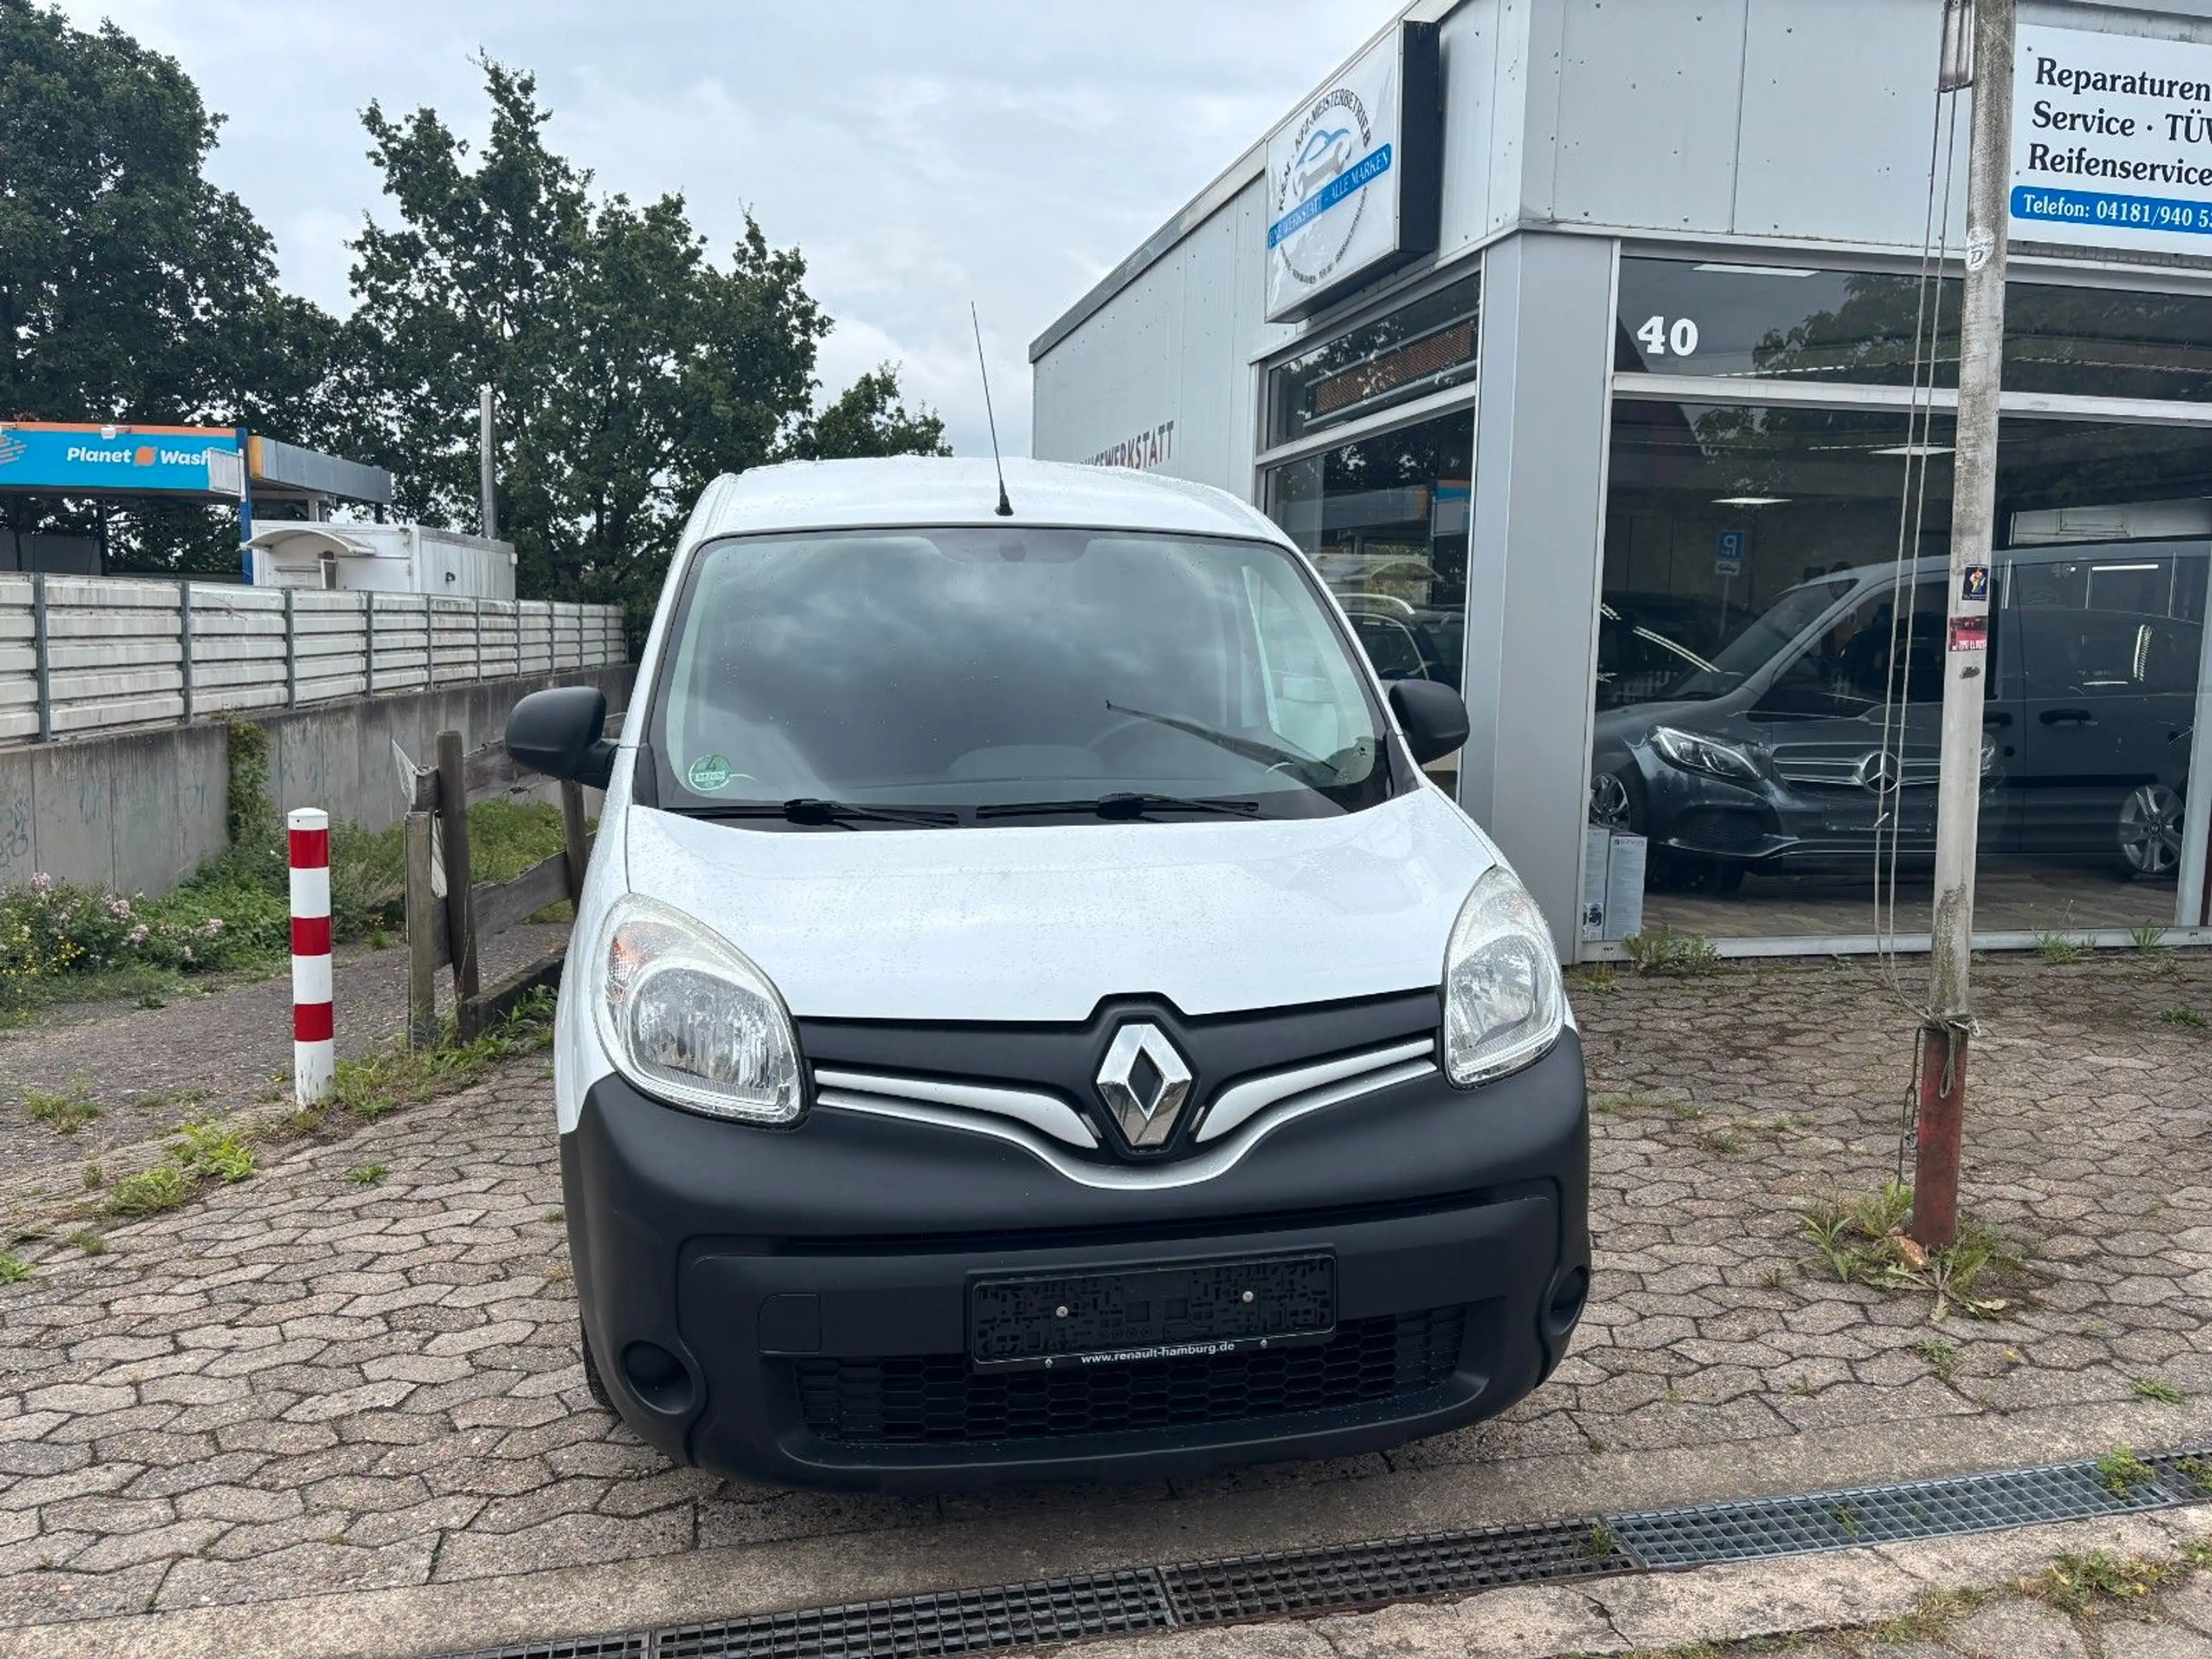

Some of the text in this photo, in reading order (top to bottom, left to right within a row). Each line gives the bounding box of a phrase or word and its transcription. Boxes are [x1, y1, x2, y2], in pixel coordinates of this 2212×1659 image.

[2035, 56, 2211, 101] Reparaturen
[2032, 100, 2135, 137] Service
[1332, 175, 1349, 199] ALLE
[1351, 151, 1388, 184] MARKEN
[2028, 143, 2212, 186] Reifenservice
[2023, 194, 2090, 218] Telefon:
[2096, 200, 2193, 226] 04181/940
[1637, 316, 1698, 357] 40
[66, 446, 132, 463] Planet
[1081, 1342, 1236, 1364] www.renault-hamburg.de
